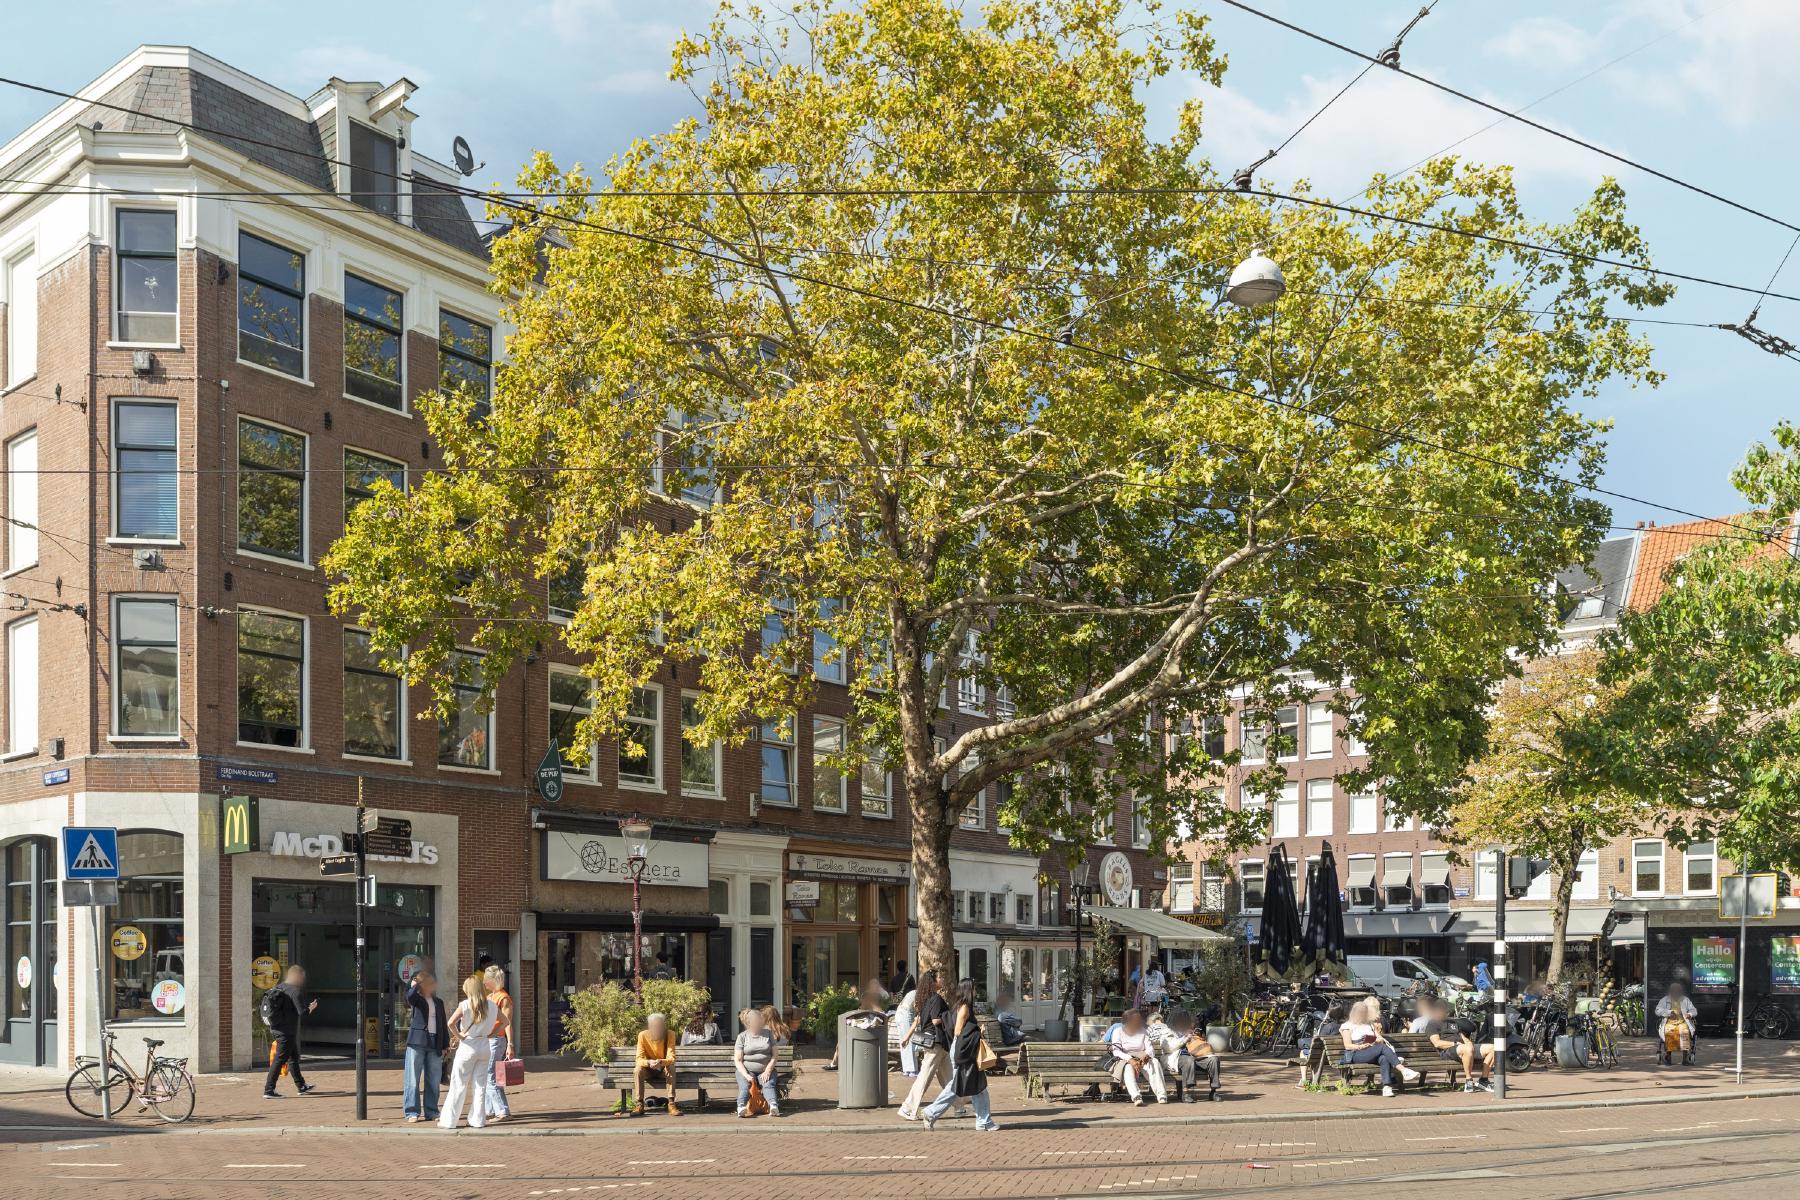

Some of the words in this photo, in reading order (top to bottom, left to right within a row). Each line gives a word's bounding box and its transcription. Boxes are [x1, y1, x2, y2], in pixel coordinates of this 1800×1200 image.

[221, 767, 247, 776] FERDINAND
[248, 770, 274, 779] BOLSTRAAT
[815, 858, 845, 872] Toko
[1696, 945, 1732, 956] Hallo
